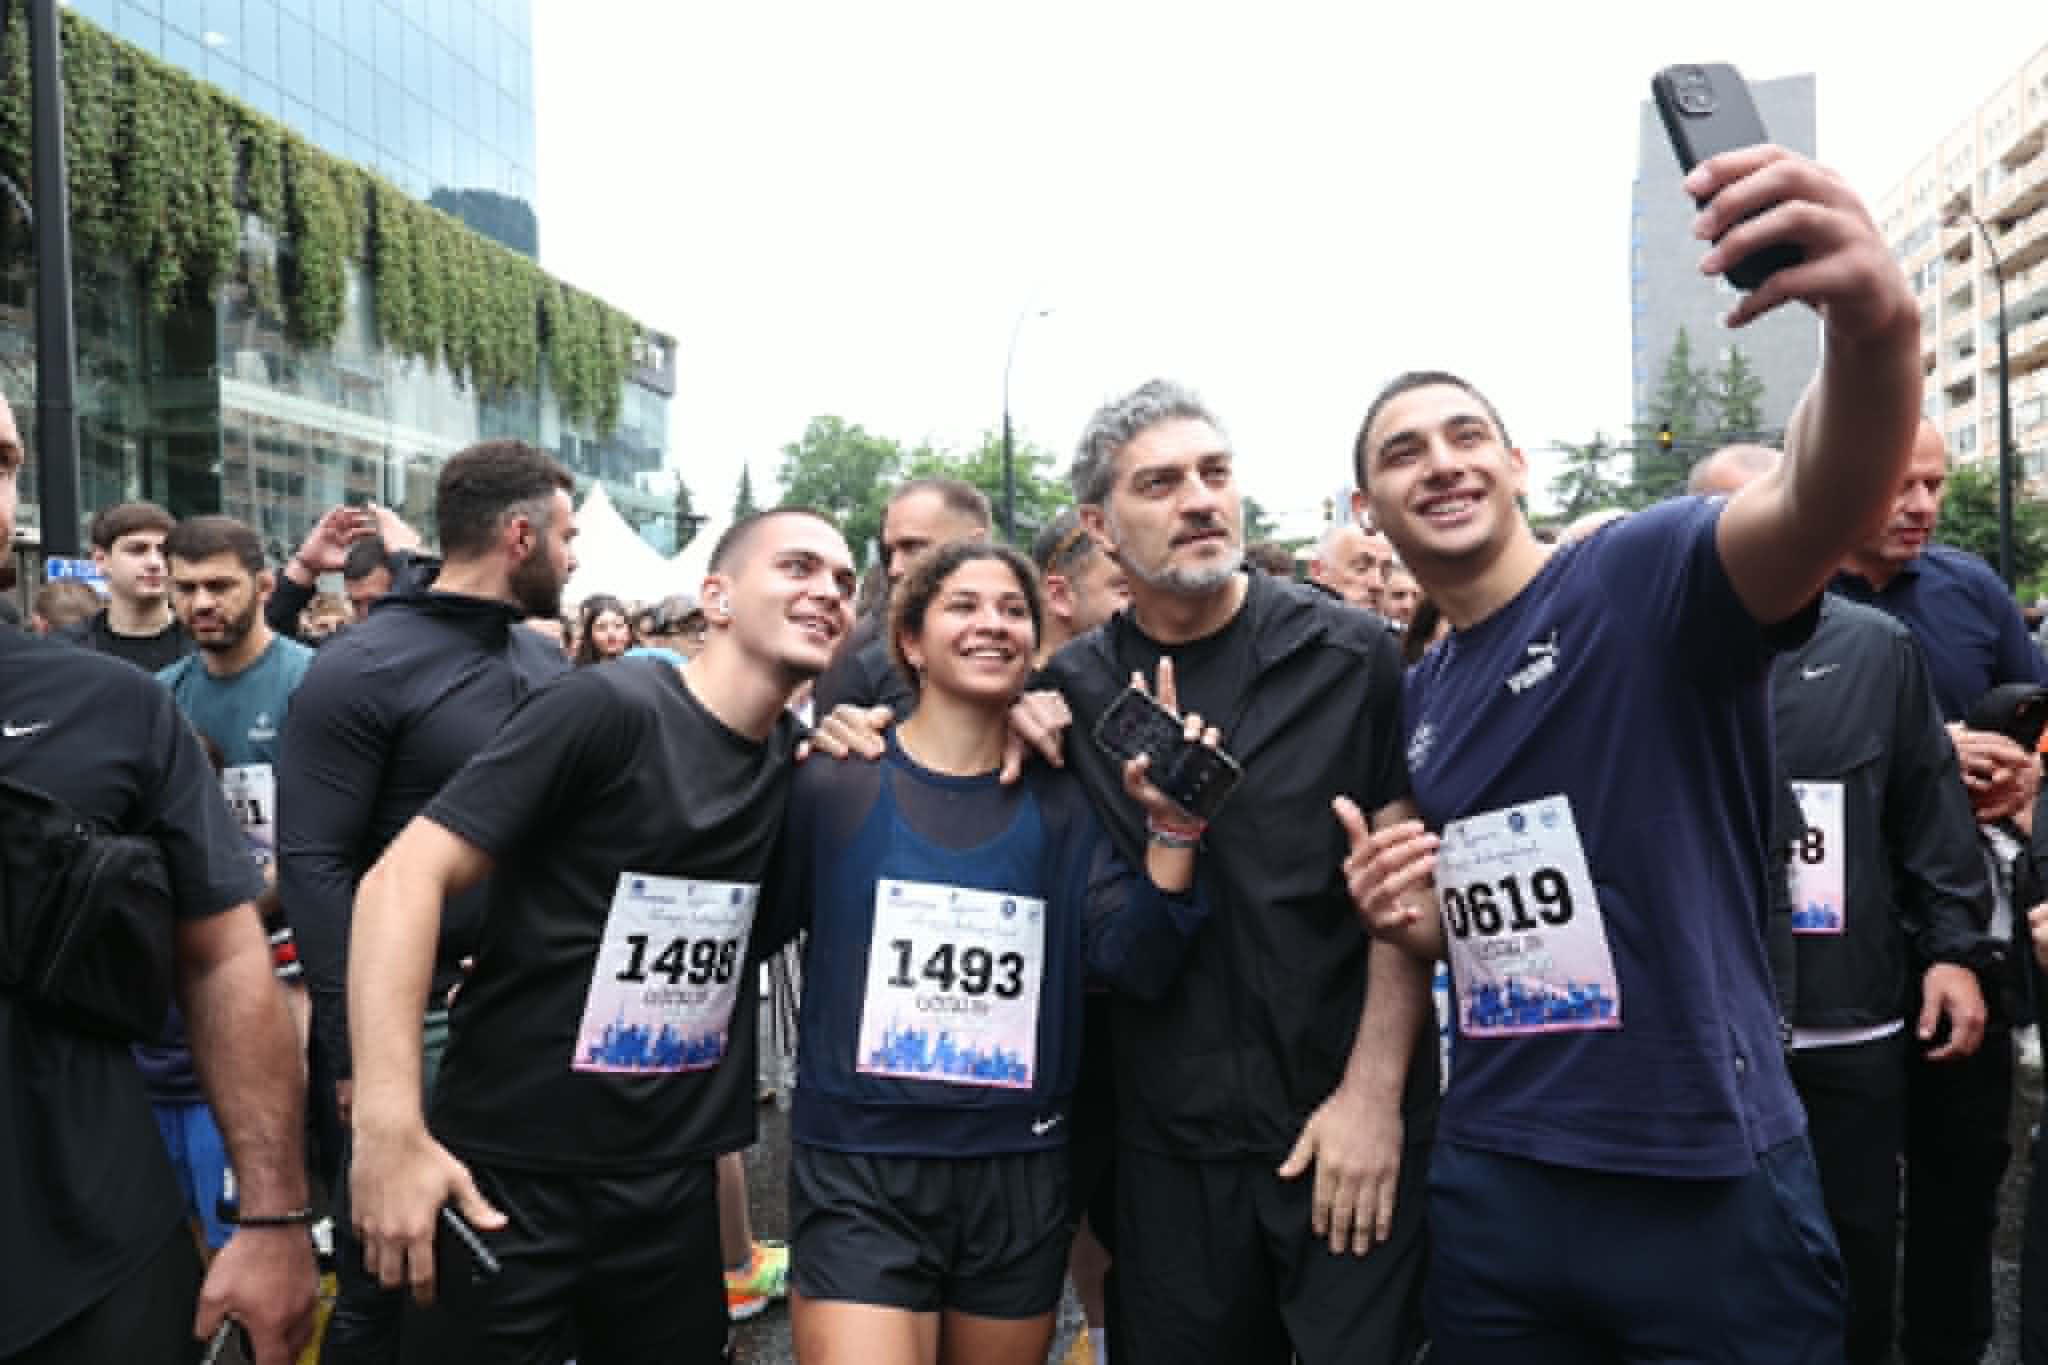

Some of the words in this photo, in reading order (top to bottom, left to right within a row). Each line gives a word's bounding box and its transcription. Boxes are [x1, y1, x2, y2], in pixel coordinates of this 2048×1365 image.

[1443, 865, 1574, 941] 0619
[616, 934, 738, 985] 1498
[887, 938, 1026, 1000] 1493
